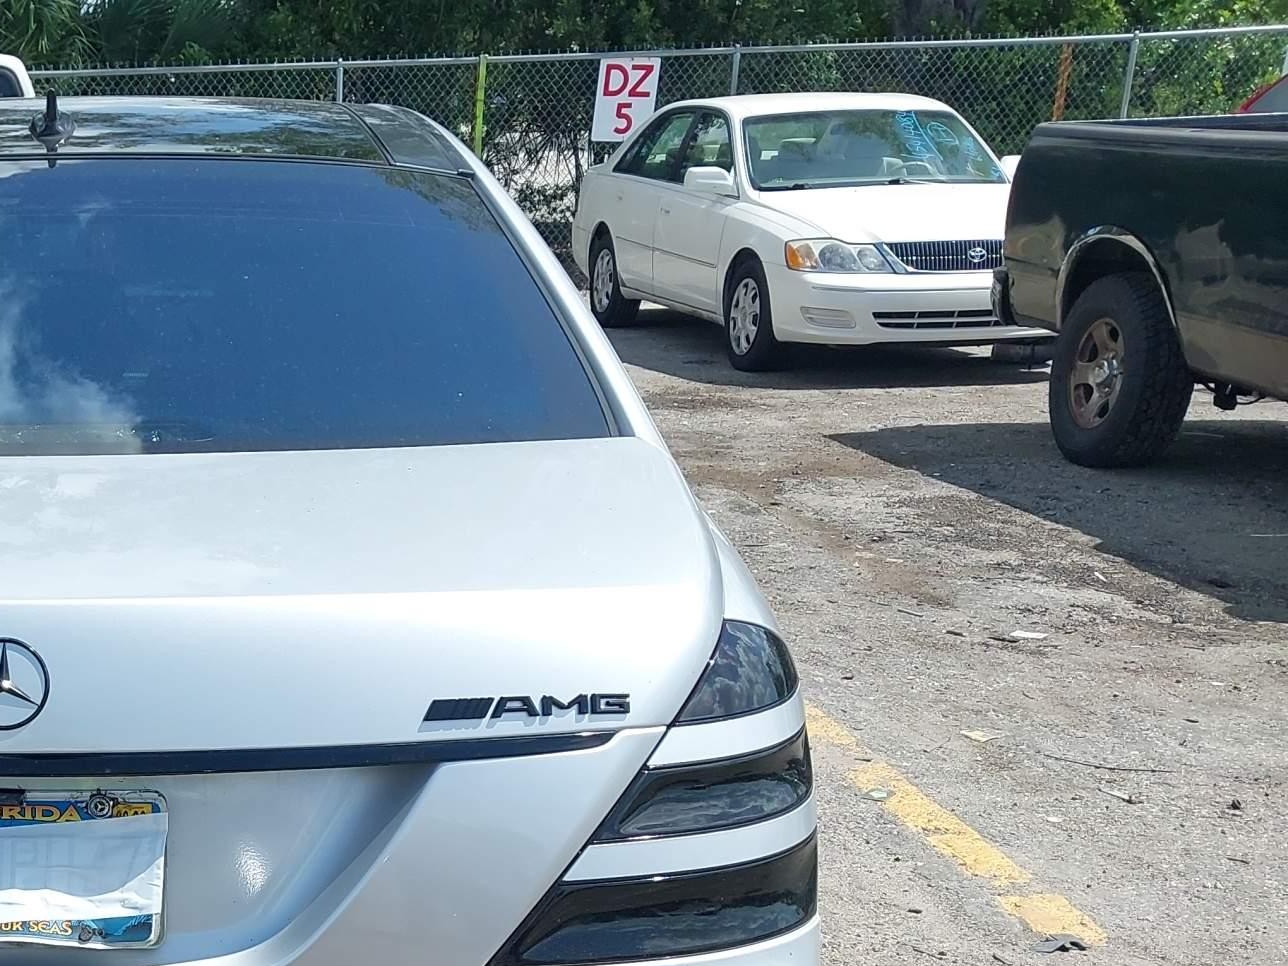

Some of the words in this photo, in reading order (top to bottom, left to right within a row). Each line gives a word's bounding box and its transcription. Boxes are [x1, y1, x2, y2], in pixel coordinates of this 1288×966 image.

[602, 64, 655, 97] DZ
[613, 103, 633, 134] 5
[489, 694, 631, 719] AMG
[28, 920, 73, 935] SEAS
